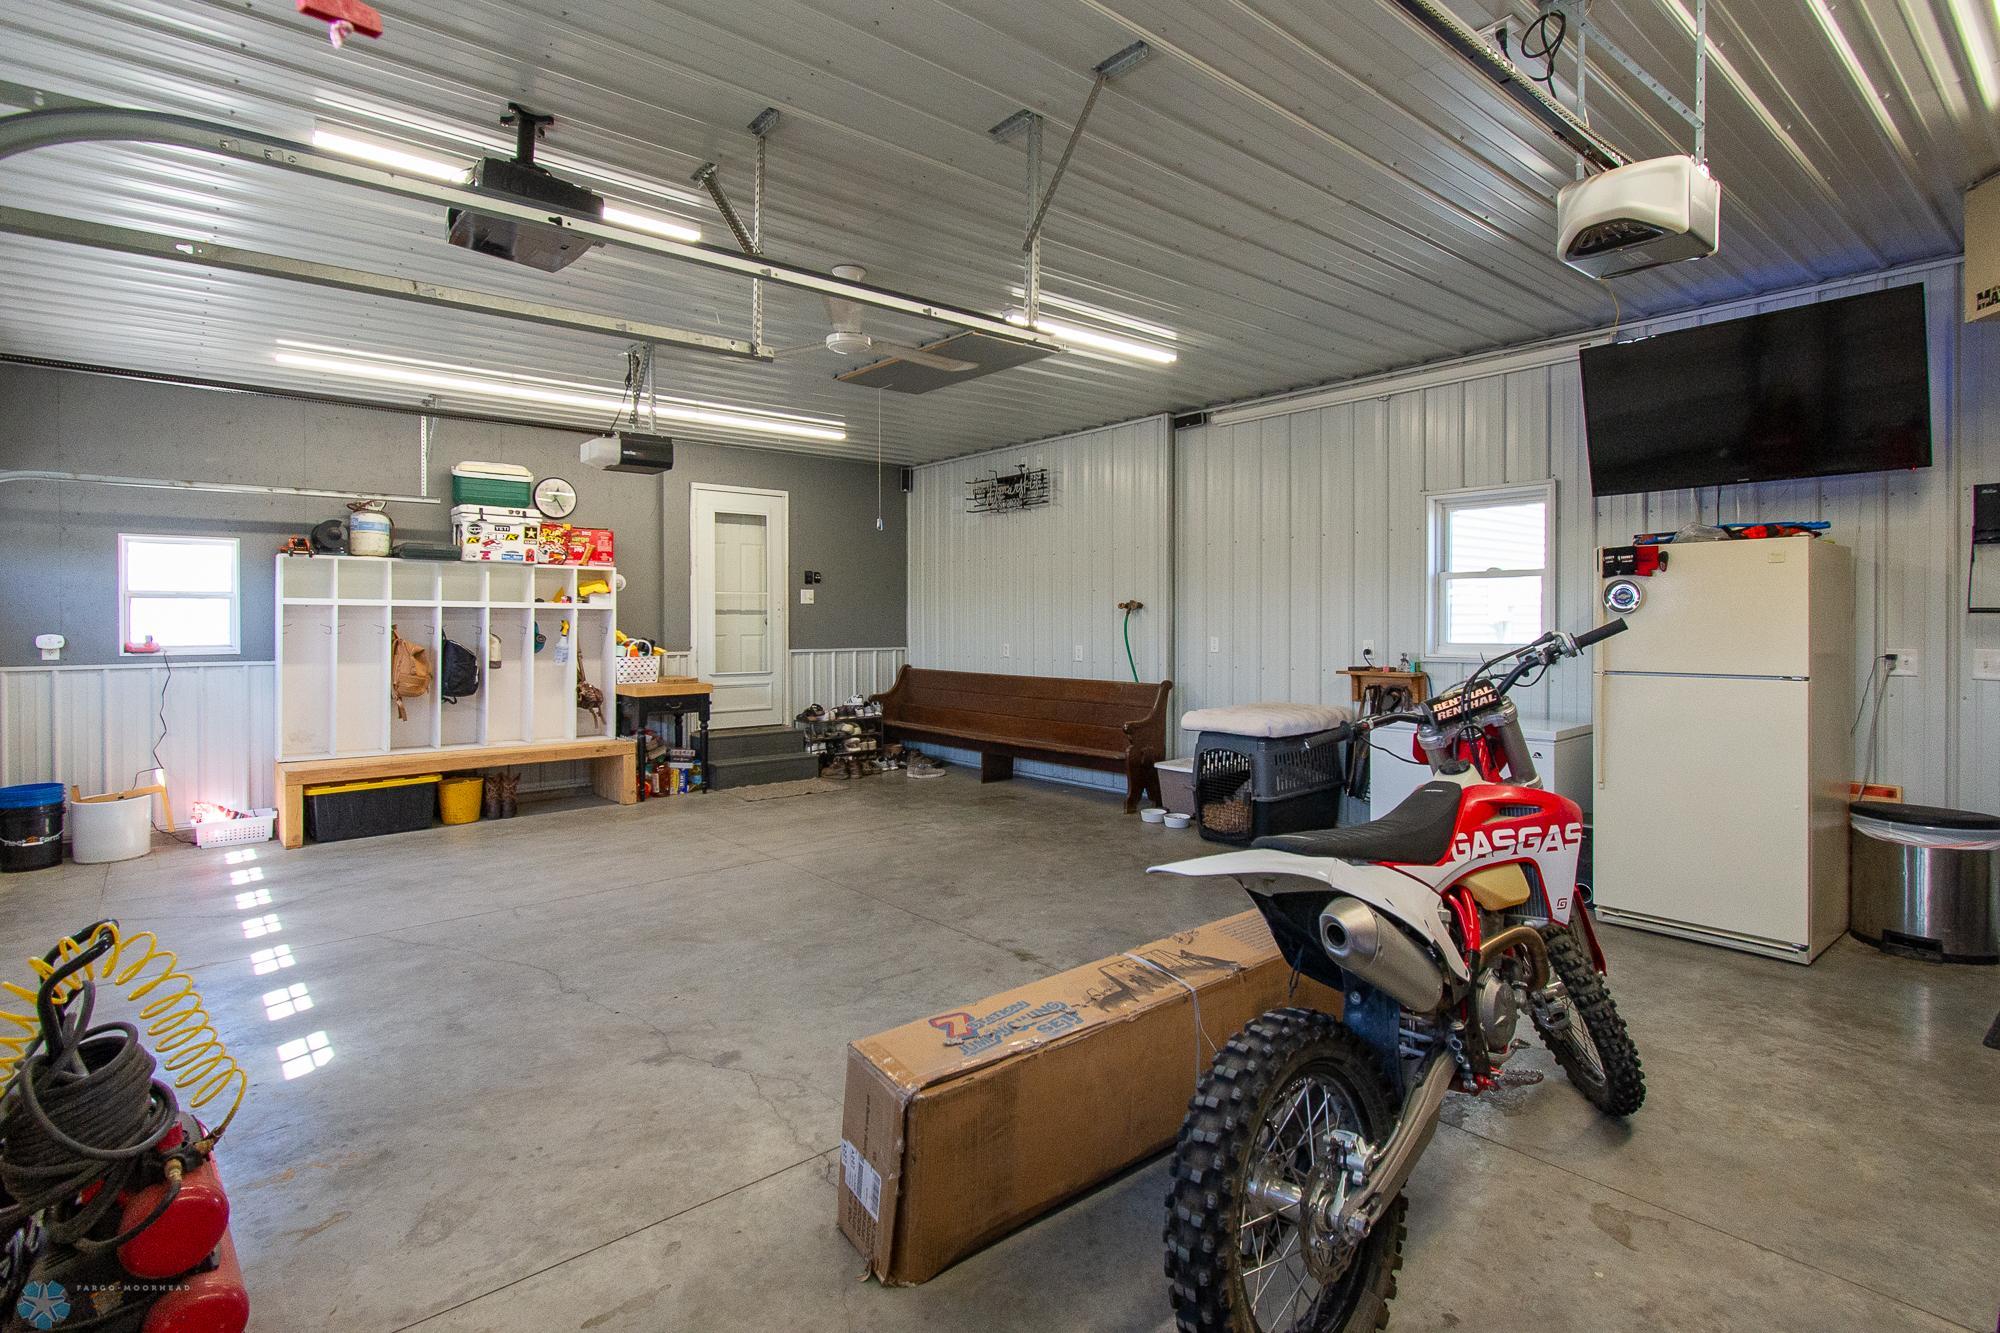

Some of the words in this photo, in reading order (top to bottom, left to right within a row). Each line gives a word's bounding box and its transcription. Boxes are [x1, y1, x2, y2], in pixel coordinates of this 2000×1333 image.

[1976, 286, 2000, 311] MA
[1437, 694, 1497, 721] RENTHAL
[1452, 822, 1582, 861] GASGAS
